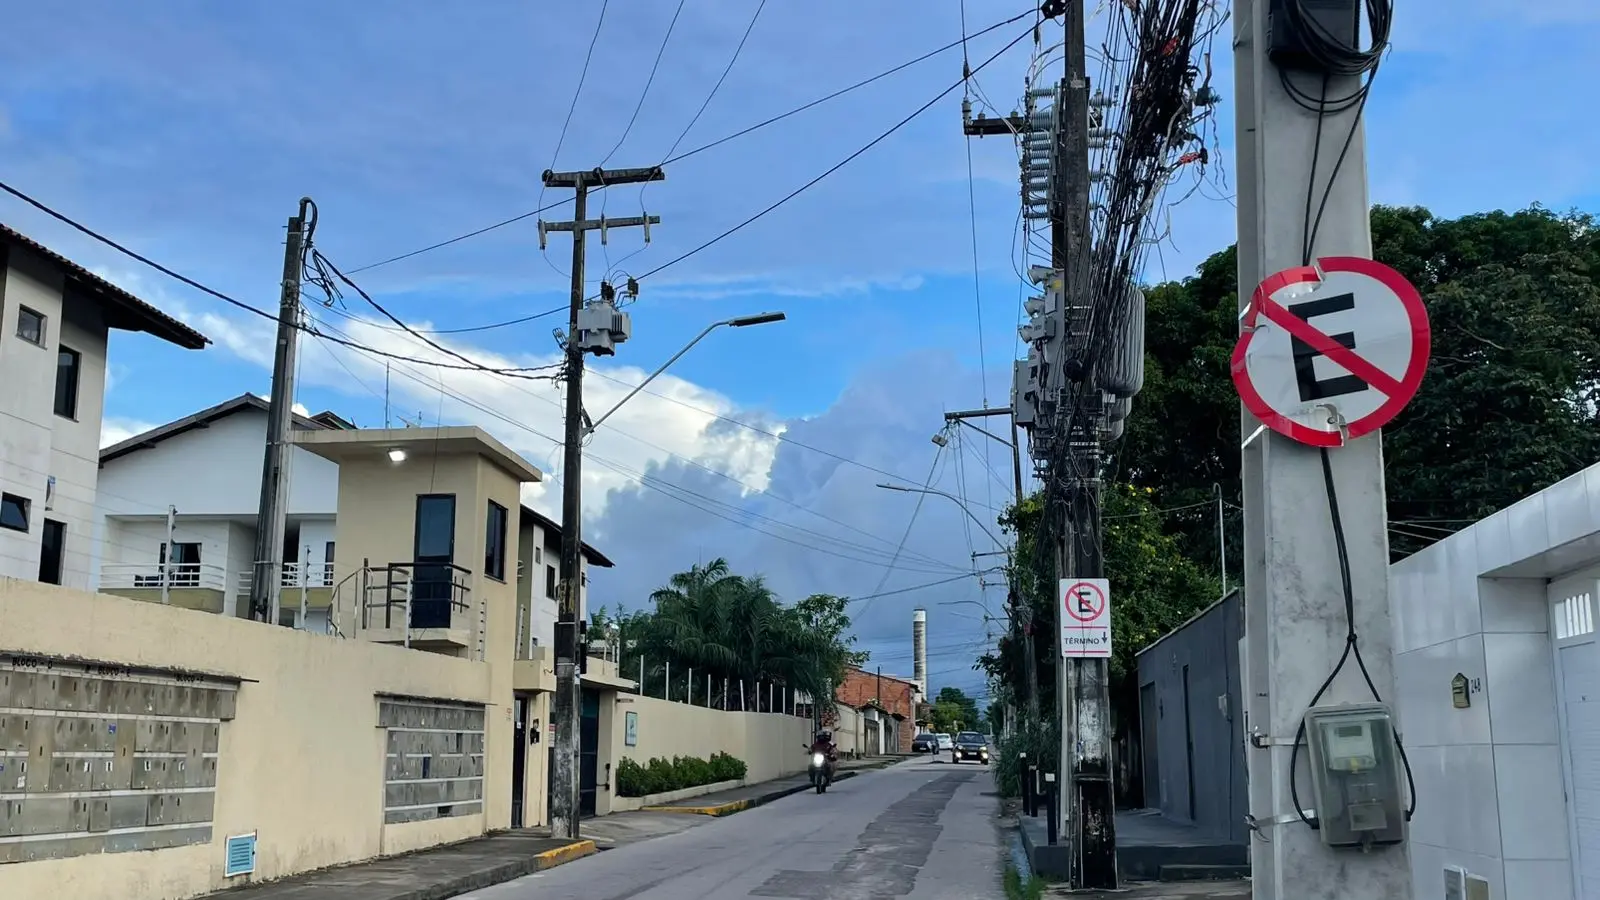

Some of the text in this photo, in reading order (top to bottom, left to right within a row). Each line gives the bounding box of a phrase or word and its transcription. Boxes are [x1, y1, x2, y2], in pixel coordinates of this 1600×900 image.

[1288, 292, 1369, 402] E
[1078, 591, 1092, 612] E
[1063, 637, 1100, 645] TÉRMINO
